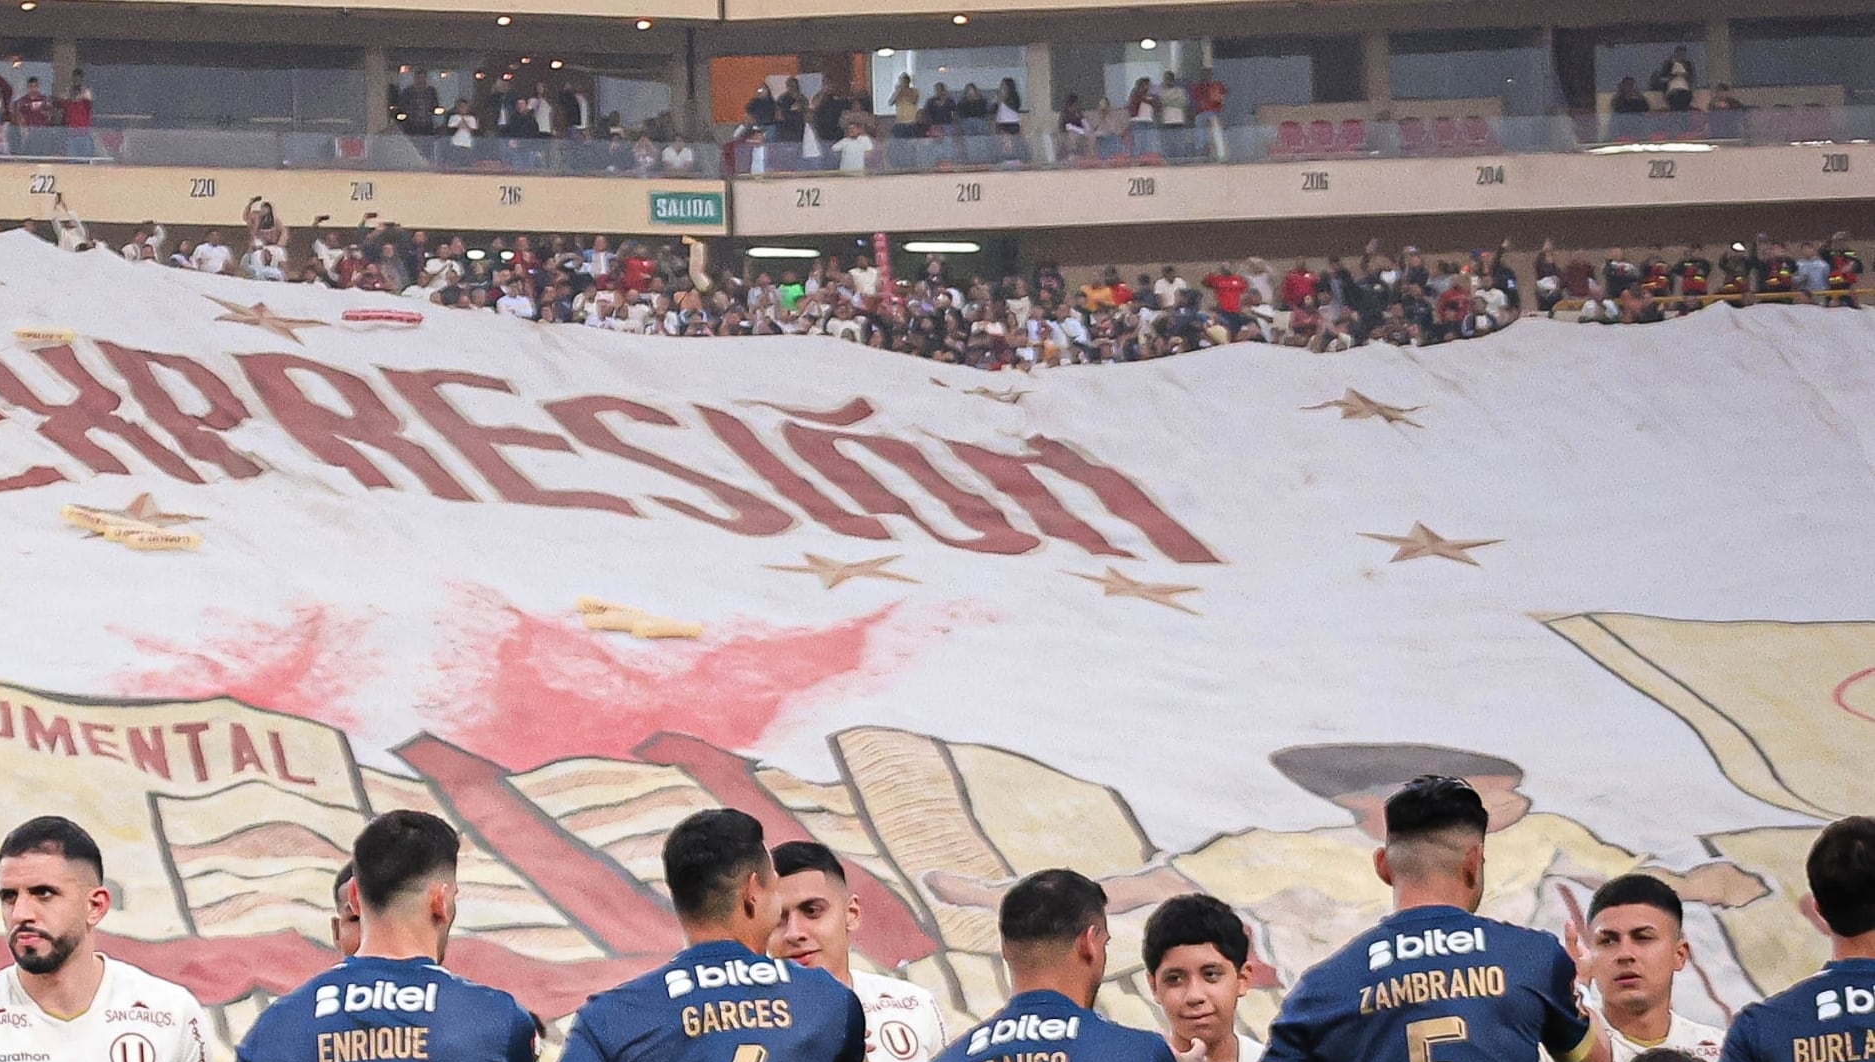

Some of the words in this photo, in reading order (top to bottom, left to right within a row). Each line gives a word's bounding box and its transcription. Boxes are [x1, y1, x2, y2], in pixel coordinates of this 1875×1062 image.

[189, 178, 215, 198] 220
[655, 193, 715, 213] SALIDA
[796, 187, 821, 208] 212
[957, 183, 981, 203] 210
[1395, 926, 1486, 959] bitel
[695, 957, 791, 990] bitel
[345, 981, 437, 1014] bitel
[1359, 965, 1506, 1015] ZAMBRANO
[681, 997, 792, 1038] GARCES
[990, 1013, 1080, 1044] bitel
